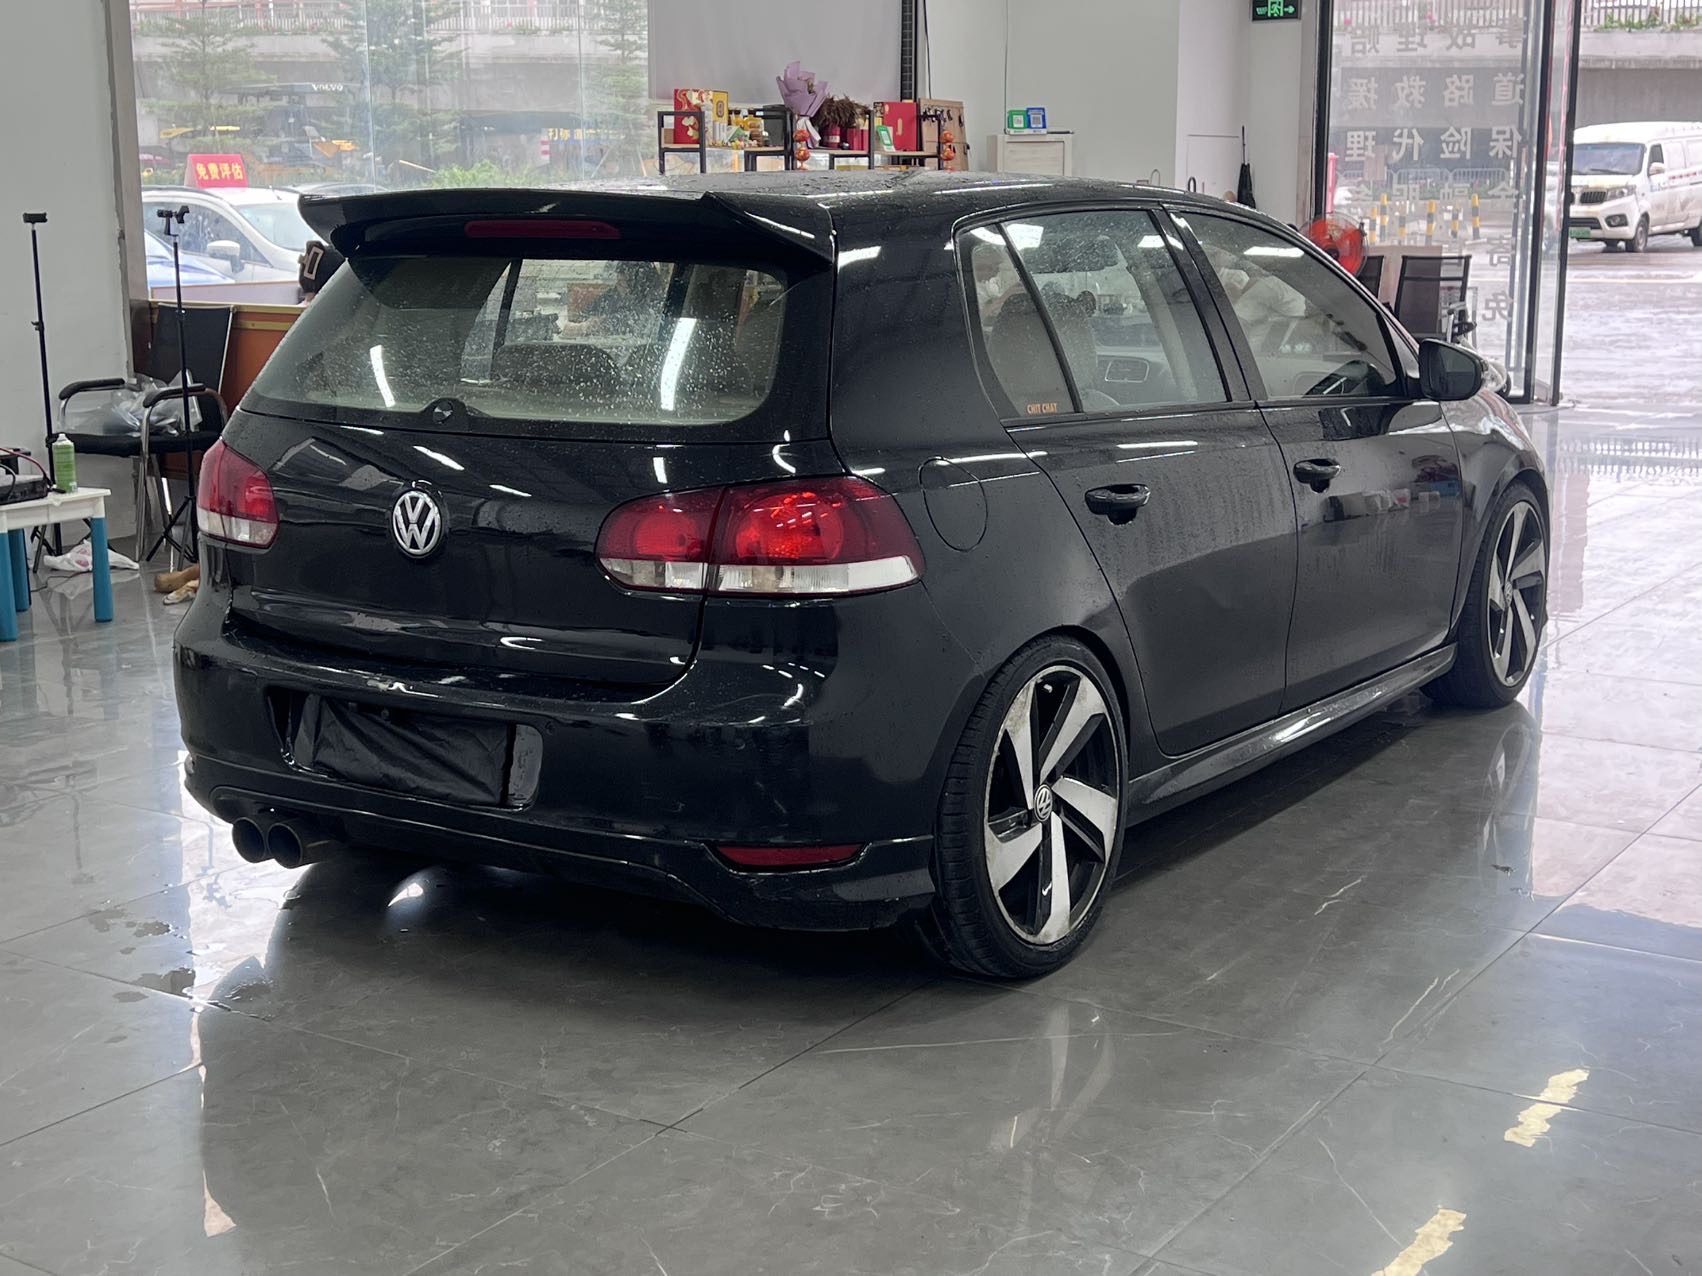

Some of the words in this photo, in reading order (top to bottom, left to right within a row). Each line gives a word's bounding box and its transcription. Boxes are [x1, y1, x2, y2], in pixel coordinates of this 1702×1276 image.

[196, 162, 244, 181] 免费评估
[1026, 403, 1041, 415] CHIT
[1041, 402, 1057, 413] CHAT
[393, 491, 441, 555] VW
